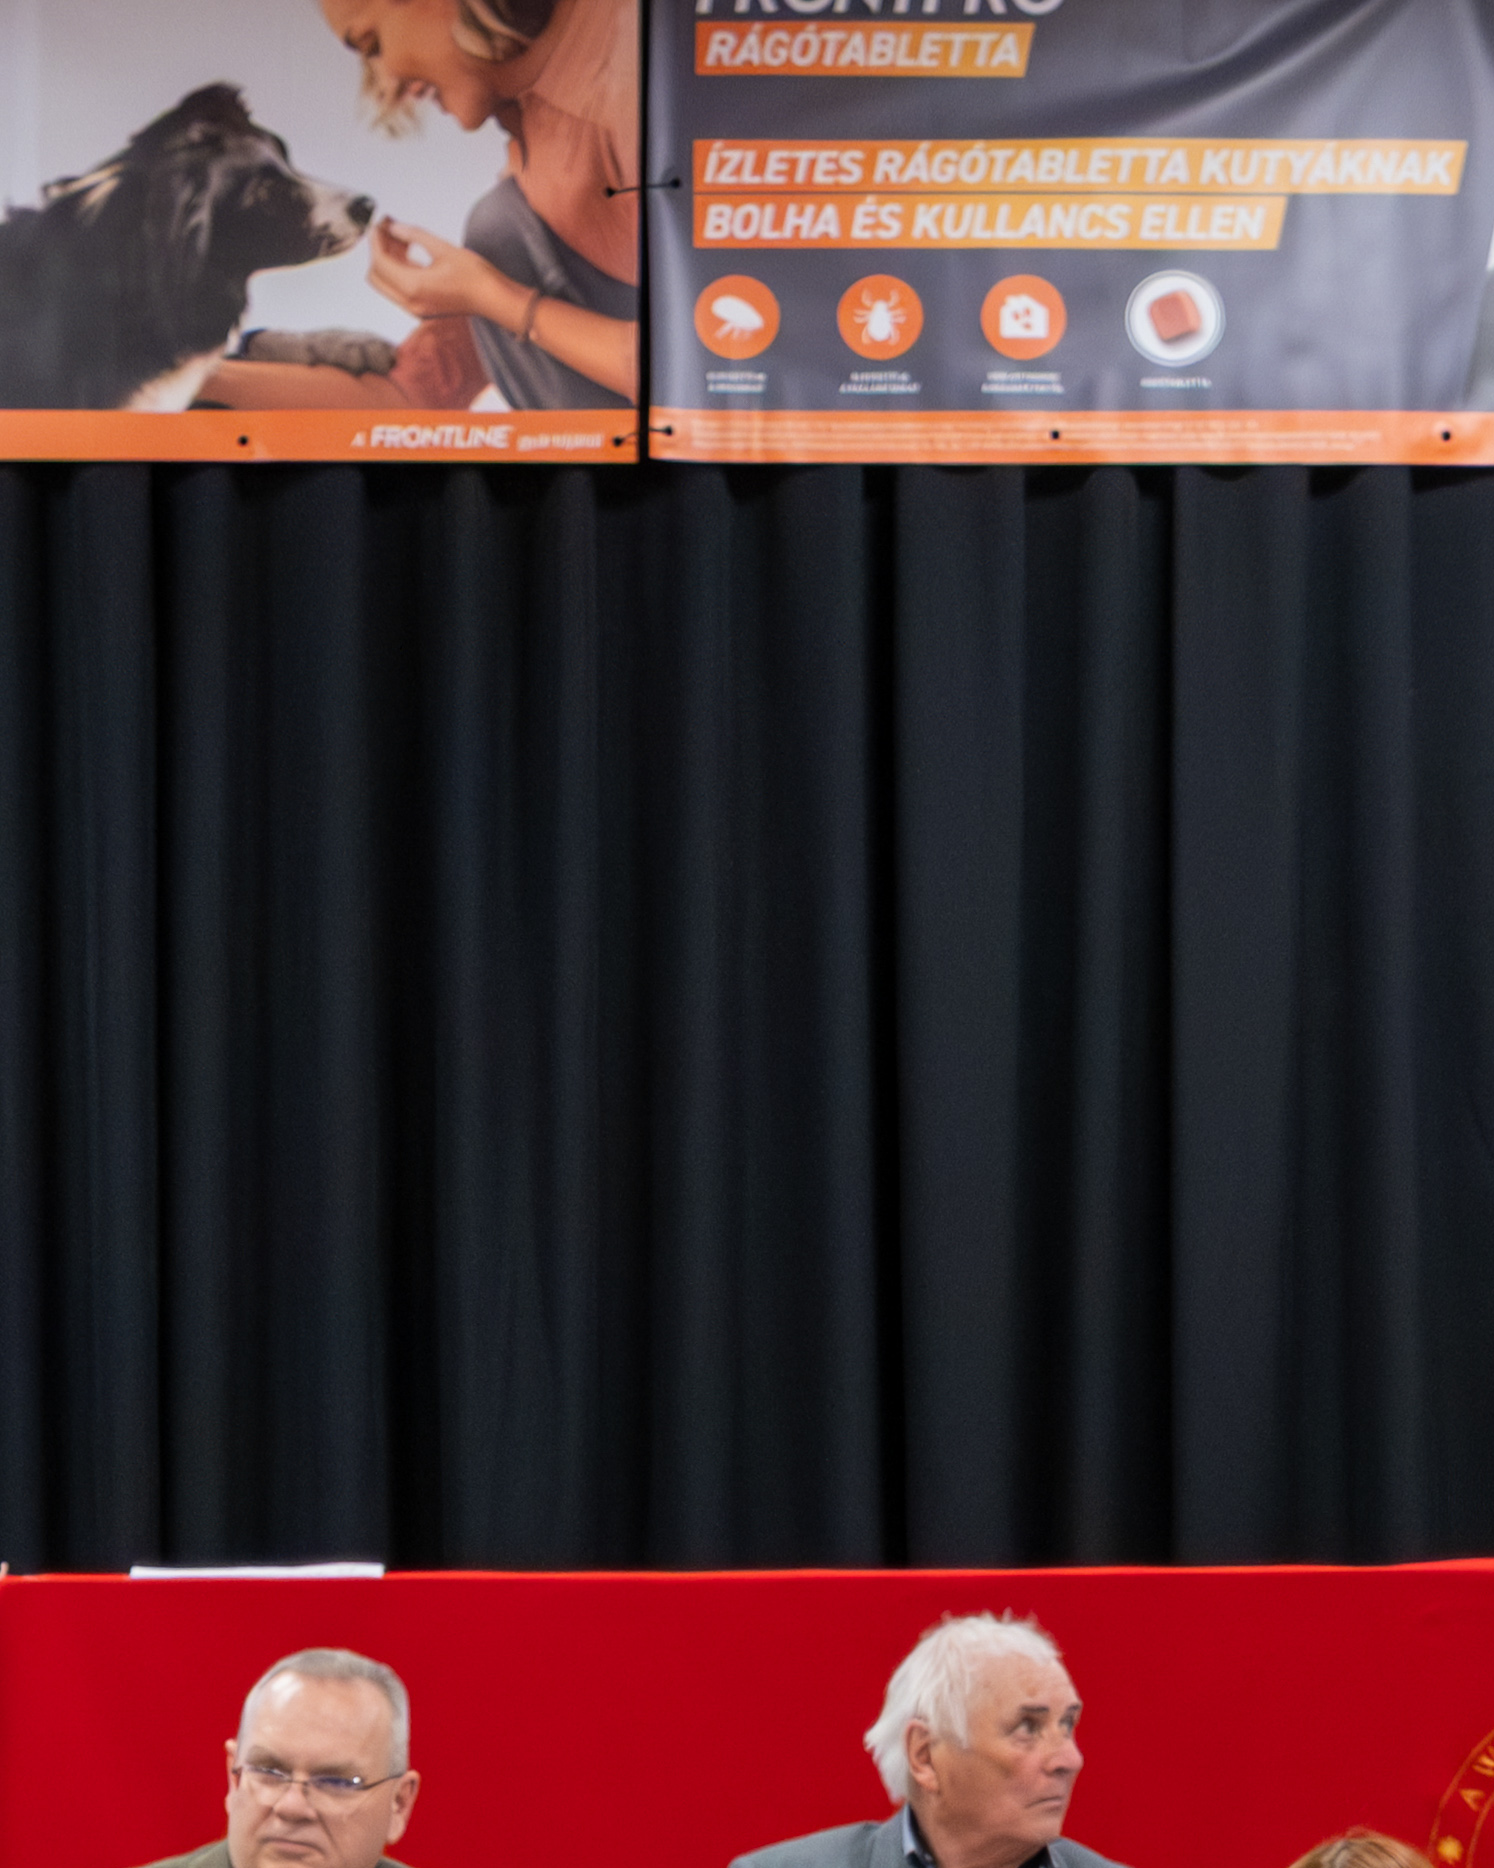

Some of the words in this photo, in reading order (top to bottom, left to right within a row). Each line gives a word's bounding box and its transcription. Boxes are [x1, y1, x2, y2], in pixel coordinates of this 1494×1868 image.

[705, 23, 1020, 67] RÁGÓTABLETTA
[703, 146, 864, 186] ÍZLETES
[873, 143, 1190, 185] RÁGÓTABLETTA
[1199, 143, 1453, 186] KUTYÁKNAK
[703, 205, 841, 240] BOLHA
[851, 196, 902, 240] ÉS
[912, 204, 1130, 240] KULLANCS
[1139, 203, 1265, 239] ELLEN
[371, 426, 513, 448] FRONTLINE
[1460, 1787, 1485, 1812] A
